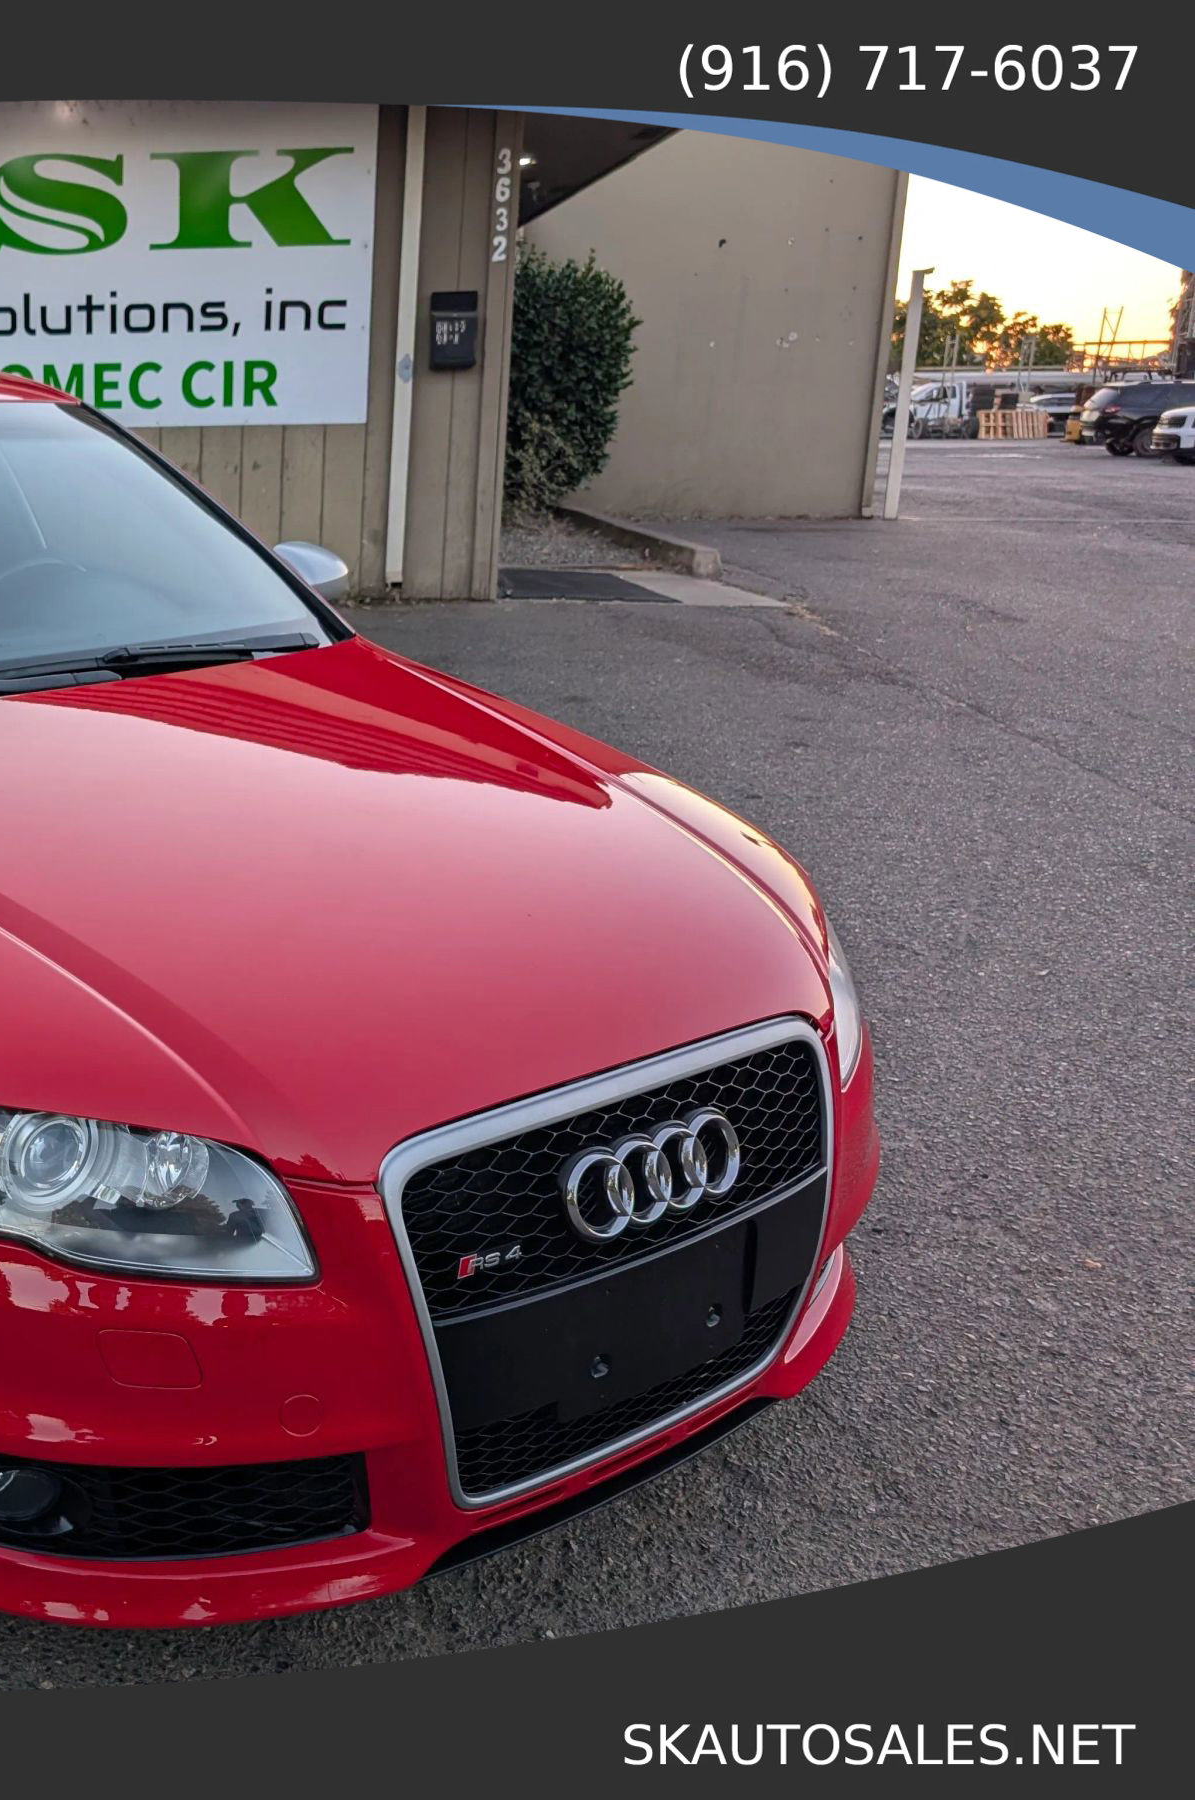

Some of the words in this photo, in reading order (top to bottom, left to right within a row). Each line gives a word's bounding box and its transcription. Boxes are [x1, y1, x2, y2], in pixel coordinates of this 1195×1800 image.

[491, 147, 512, 263] 3632
[262, 288, 348, 333] inc
[181, 359, 279, 408] CIR
